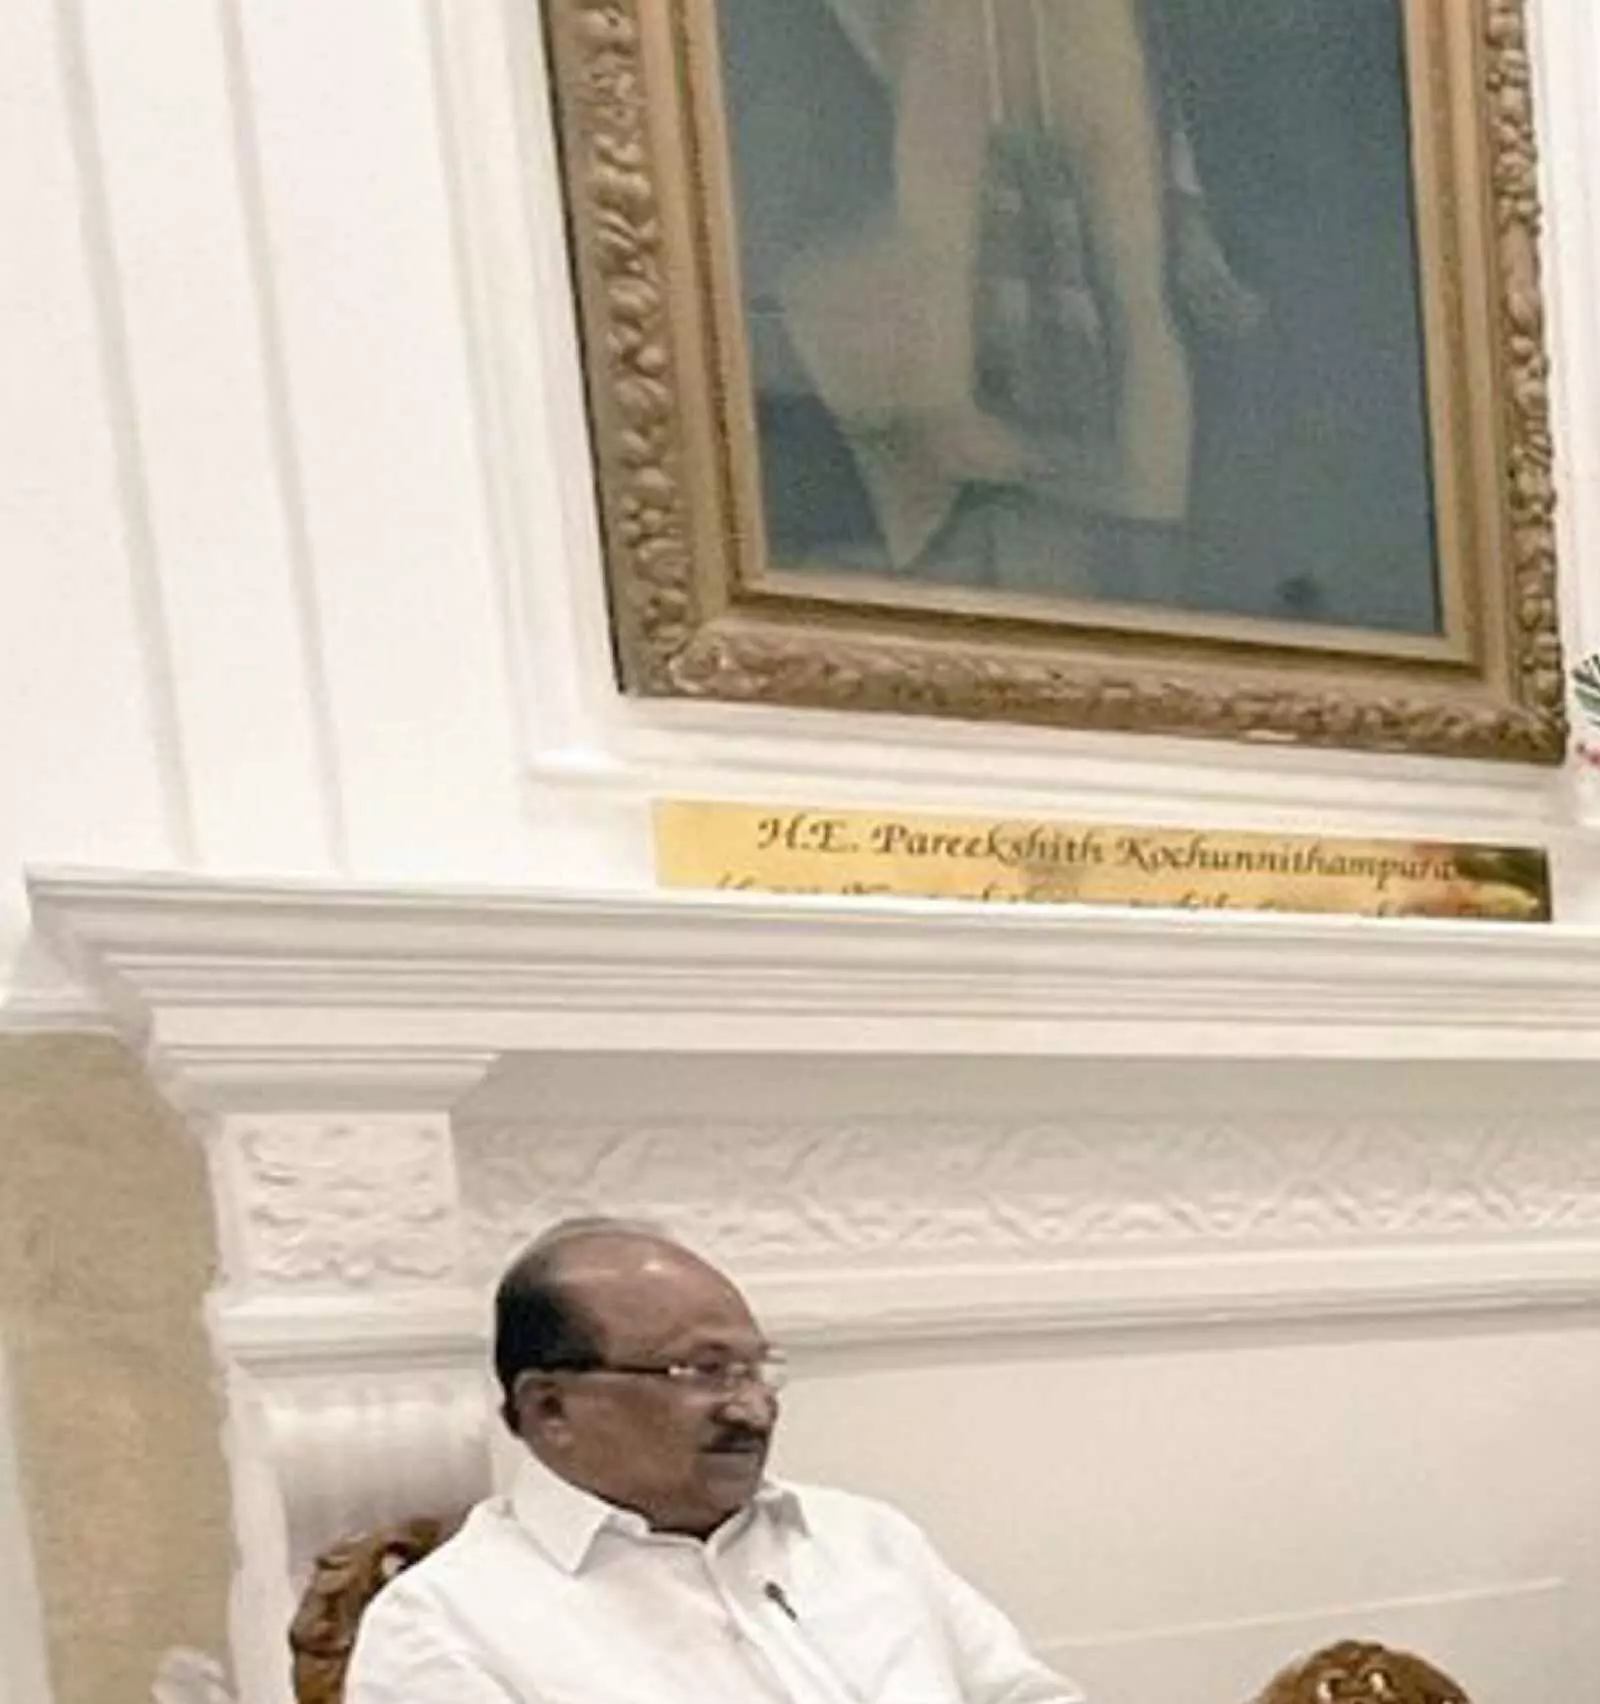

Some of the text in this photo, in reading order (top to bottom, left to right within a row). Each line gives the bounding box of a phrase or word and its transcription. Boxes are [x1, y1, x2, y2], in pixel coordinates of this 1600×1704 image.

[757, 813, 1458, 890] H.E. Pareekshith Kochunnithampura
